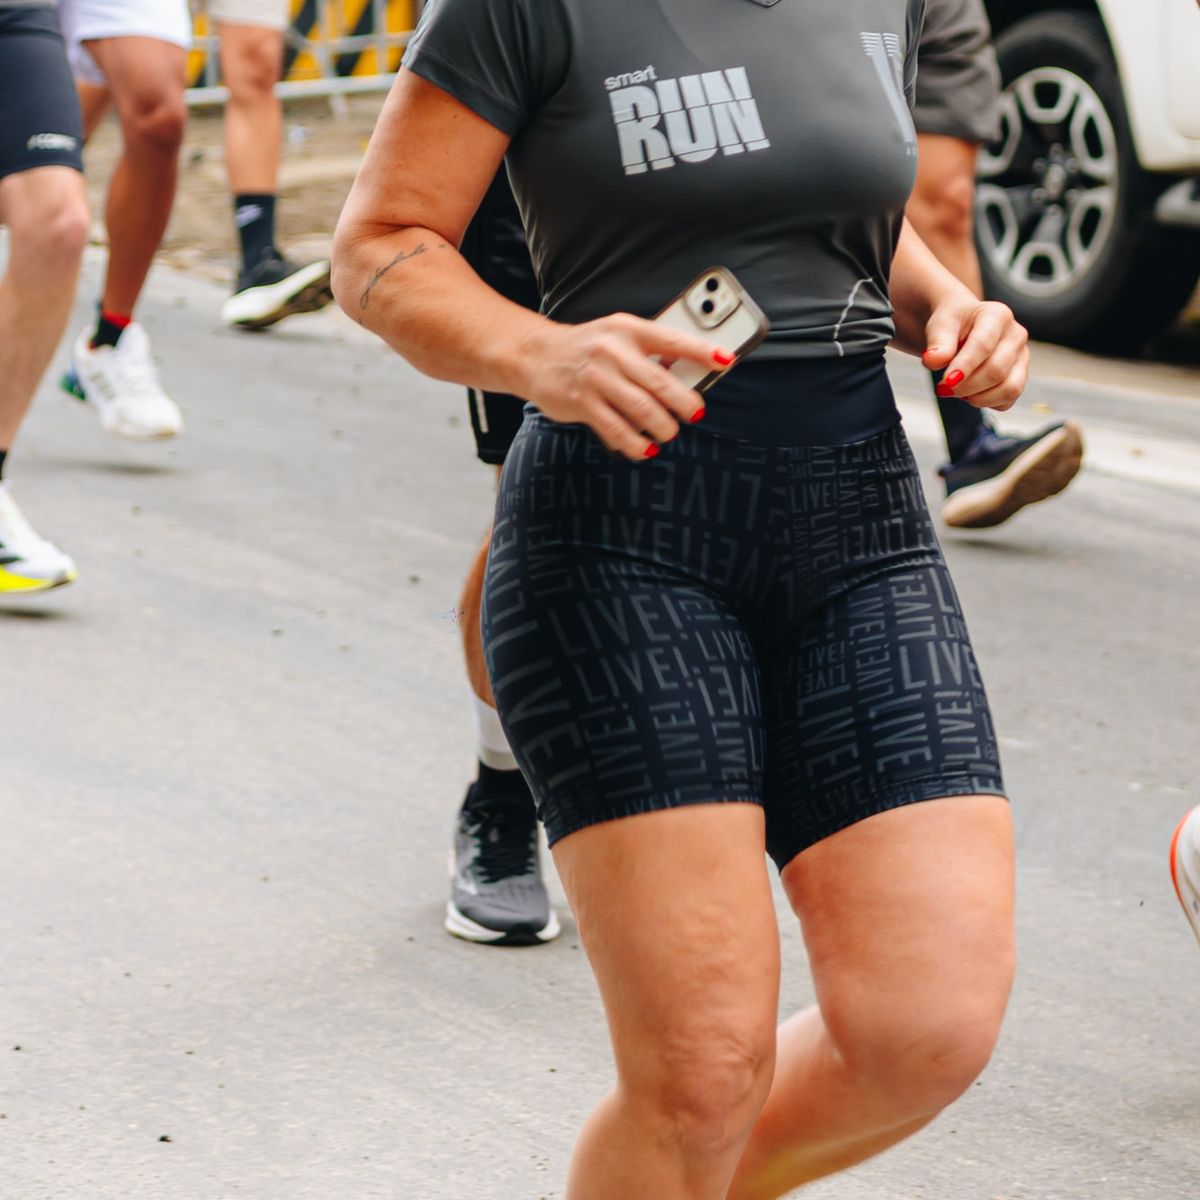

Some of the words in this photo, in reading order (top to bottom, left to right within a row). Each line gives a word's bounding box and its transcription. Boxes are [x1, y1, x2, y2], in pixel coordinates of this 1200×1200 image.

[604, 64, 657, 90] smart
[608, 66, 771, 175] RUN
[532, 432, 614, 468] LIVE
[789, 481, 838, 514] LIVE!
[549, 592, 690, 656] LIVE!
[888, 573, 937, 640] LIVE!
[573, 645, 695, 704] LIVE!
[798, 640, 846, 673] LIVE!
[855, 643, 895, 705] LIVE!
[899, 640, 983, 692] LIVE
[578, 701, 653, 800] LIVE!
[649, 700, 708, 779] LIVE!
[798, 682, 862, 791] LIVE!
[933, 689, 982, 761] LIVE!
